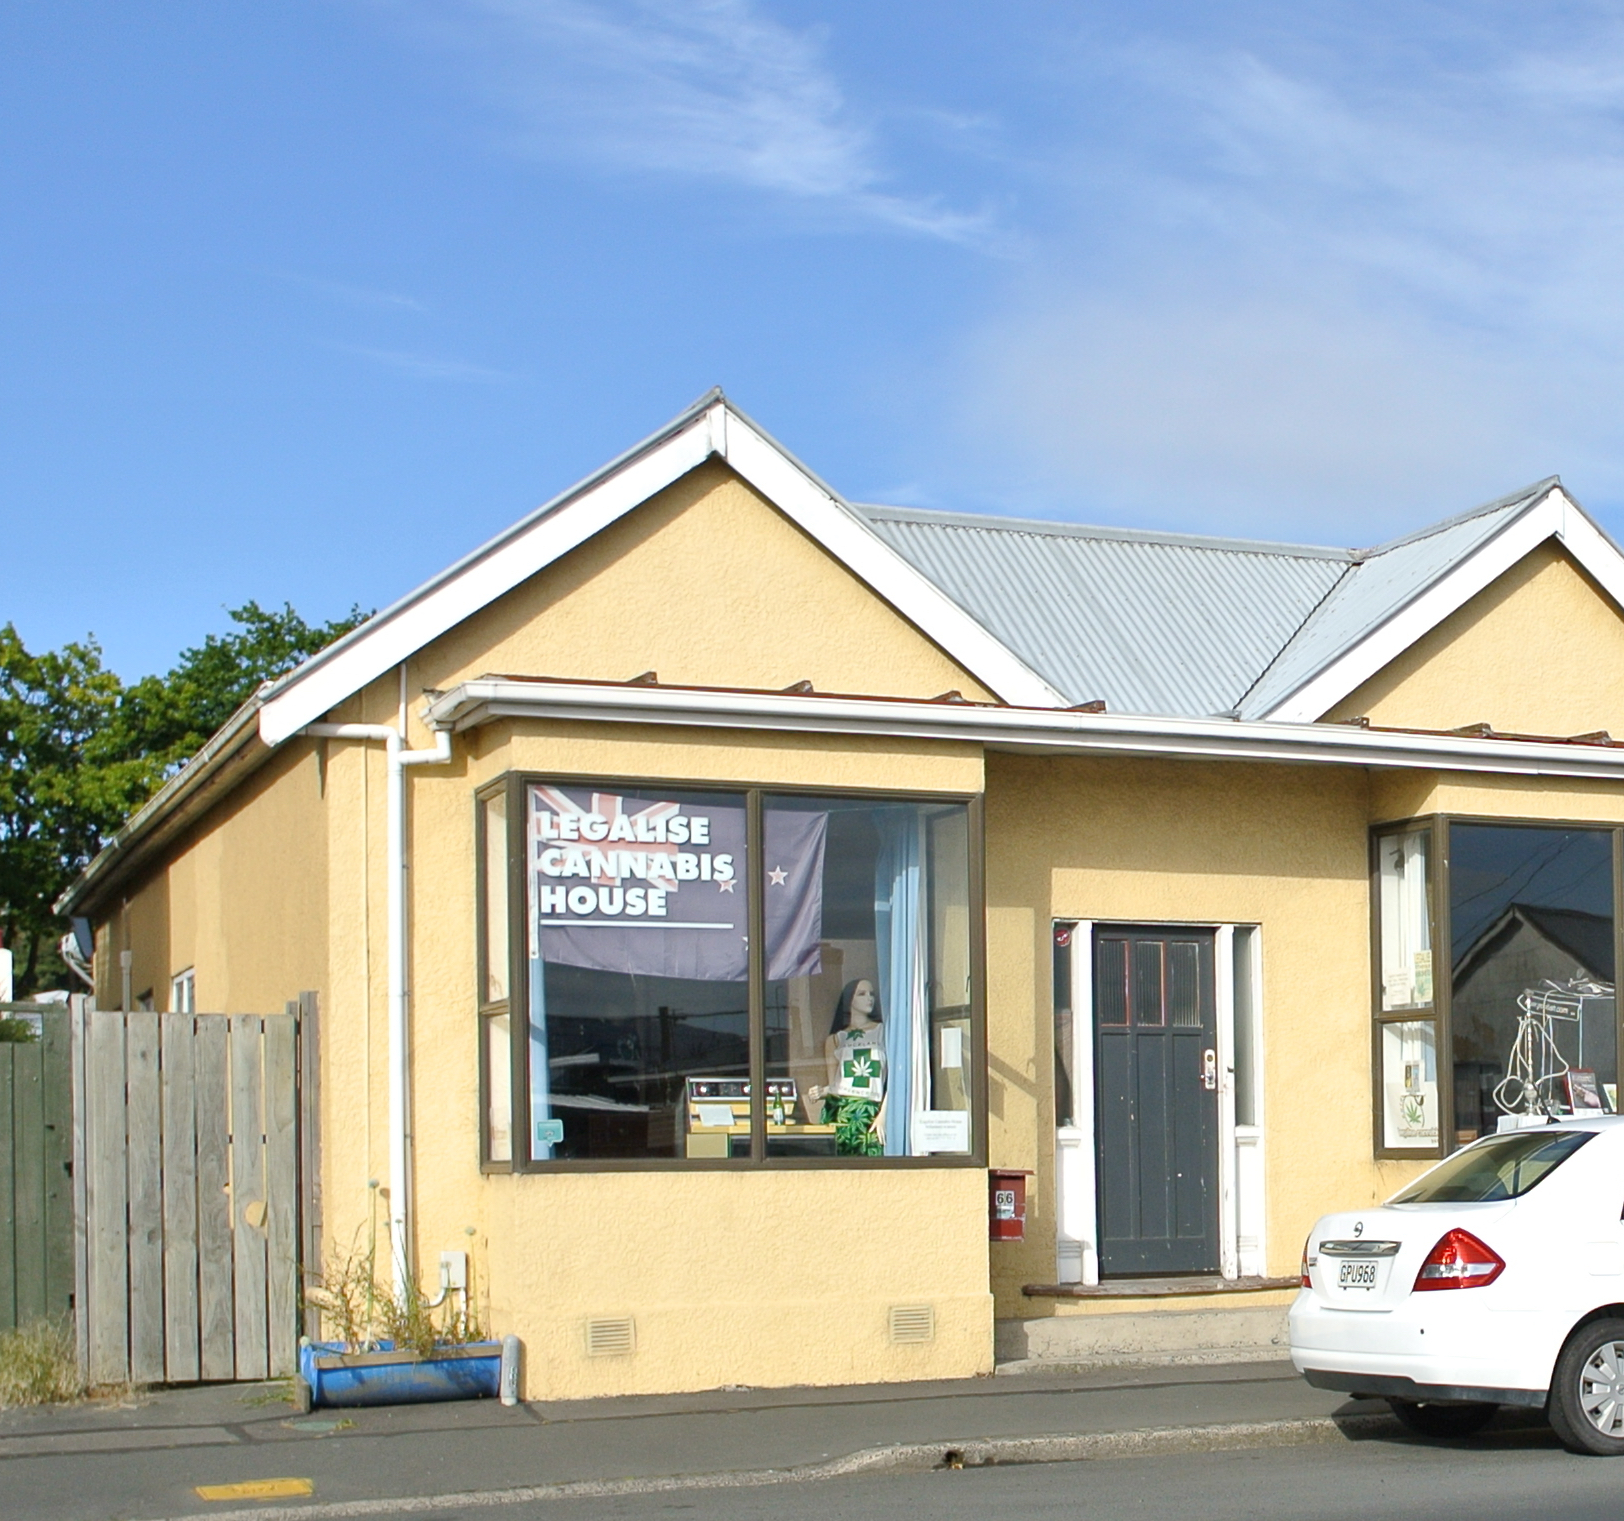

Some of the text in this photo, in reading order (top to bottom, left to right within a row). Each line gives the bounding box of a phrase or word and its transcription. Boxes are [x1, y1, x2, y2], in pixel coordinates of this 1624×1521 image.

[539, 811, 710, 845] LEGALISE
[538, 848, 735, 882] CANNABIS
[540, 885, 667, 916] HOUSE
[997, 1193, 1013, 1204] 66
[1340, 1265, 1376, 1283] GPU968
